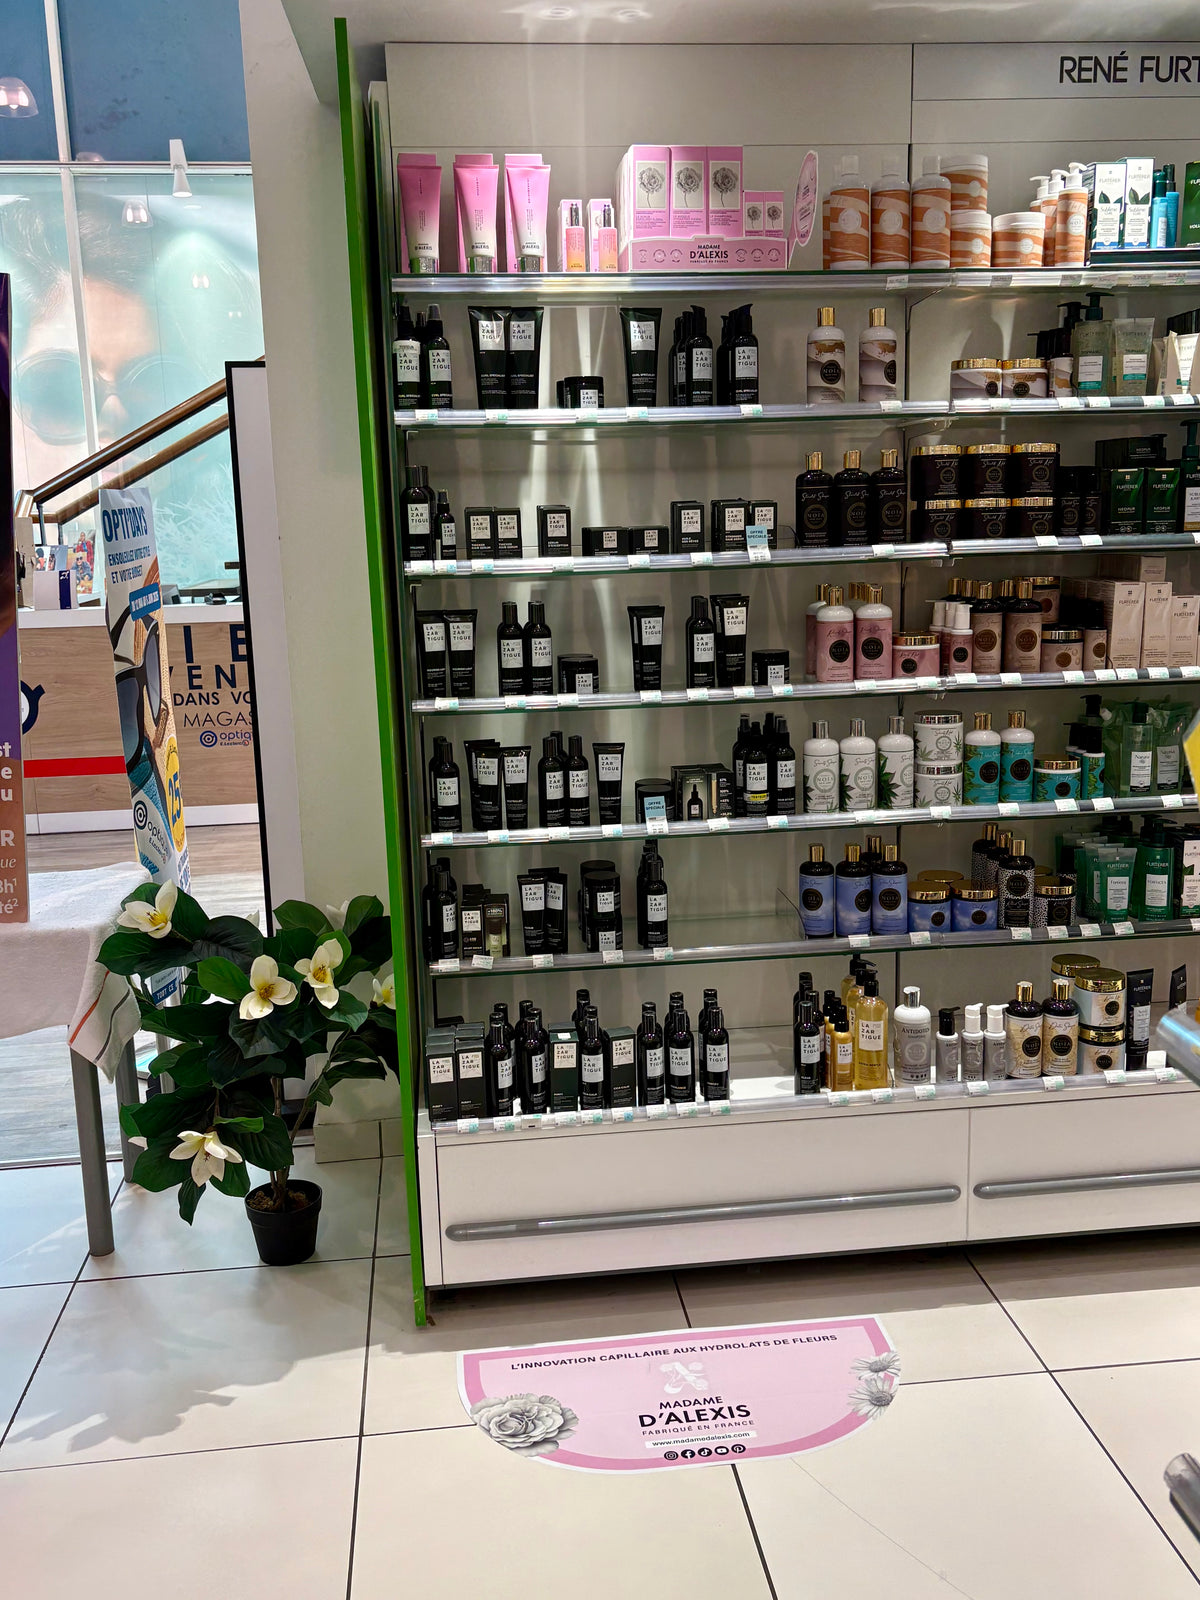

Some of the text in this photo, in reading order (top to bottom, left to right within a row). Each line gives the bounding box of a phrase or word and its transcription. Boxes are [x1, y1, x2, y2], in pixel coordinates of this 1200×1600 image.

[1059, 51, 1129, 83] RENÉ
[690, 251, 729, 259] D'ALEXIS
[111, 572, 119, 584] ET
[119, 567, 132, 582] VOTRE
[173, 692, 220, 706] DANS
[511, 1356, 596, 1370] L'INNOVATION
[600, 1349, 670, 1361] CAPILLAIRE
[673, 1346, 697, 1354] AUX
[700, 1340, 770, 1352] HYDROLATS
[793, 1334, 838, 1344] FLEURS
[660, 1396, 723, 1409] MADAME
[639, 1405, 751, 1427] D'ALEXIS
[642, 1426, 693, 1436] FABRIQUÉ
[715, 1420, 754, 1429] FRANCE
[652, 1432, 750, 1447] www.madamedalexis.com
